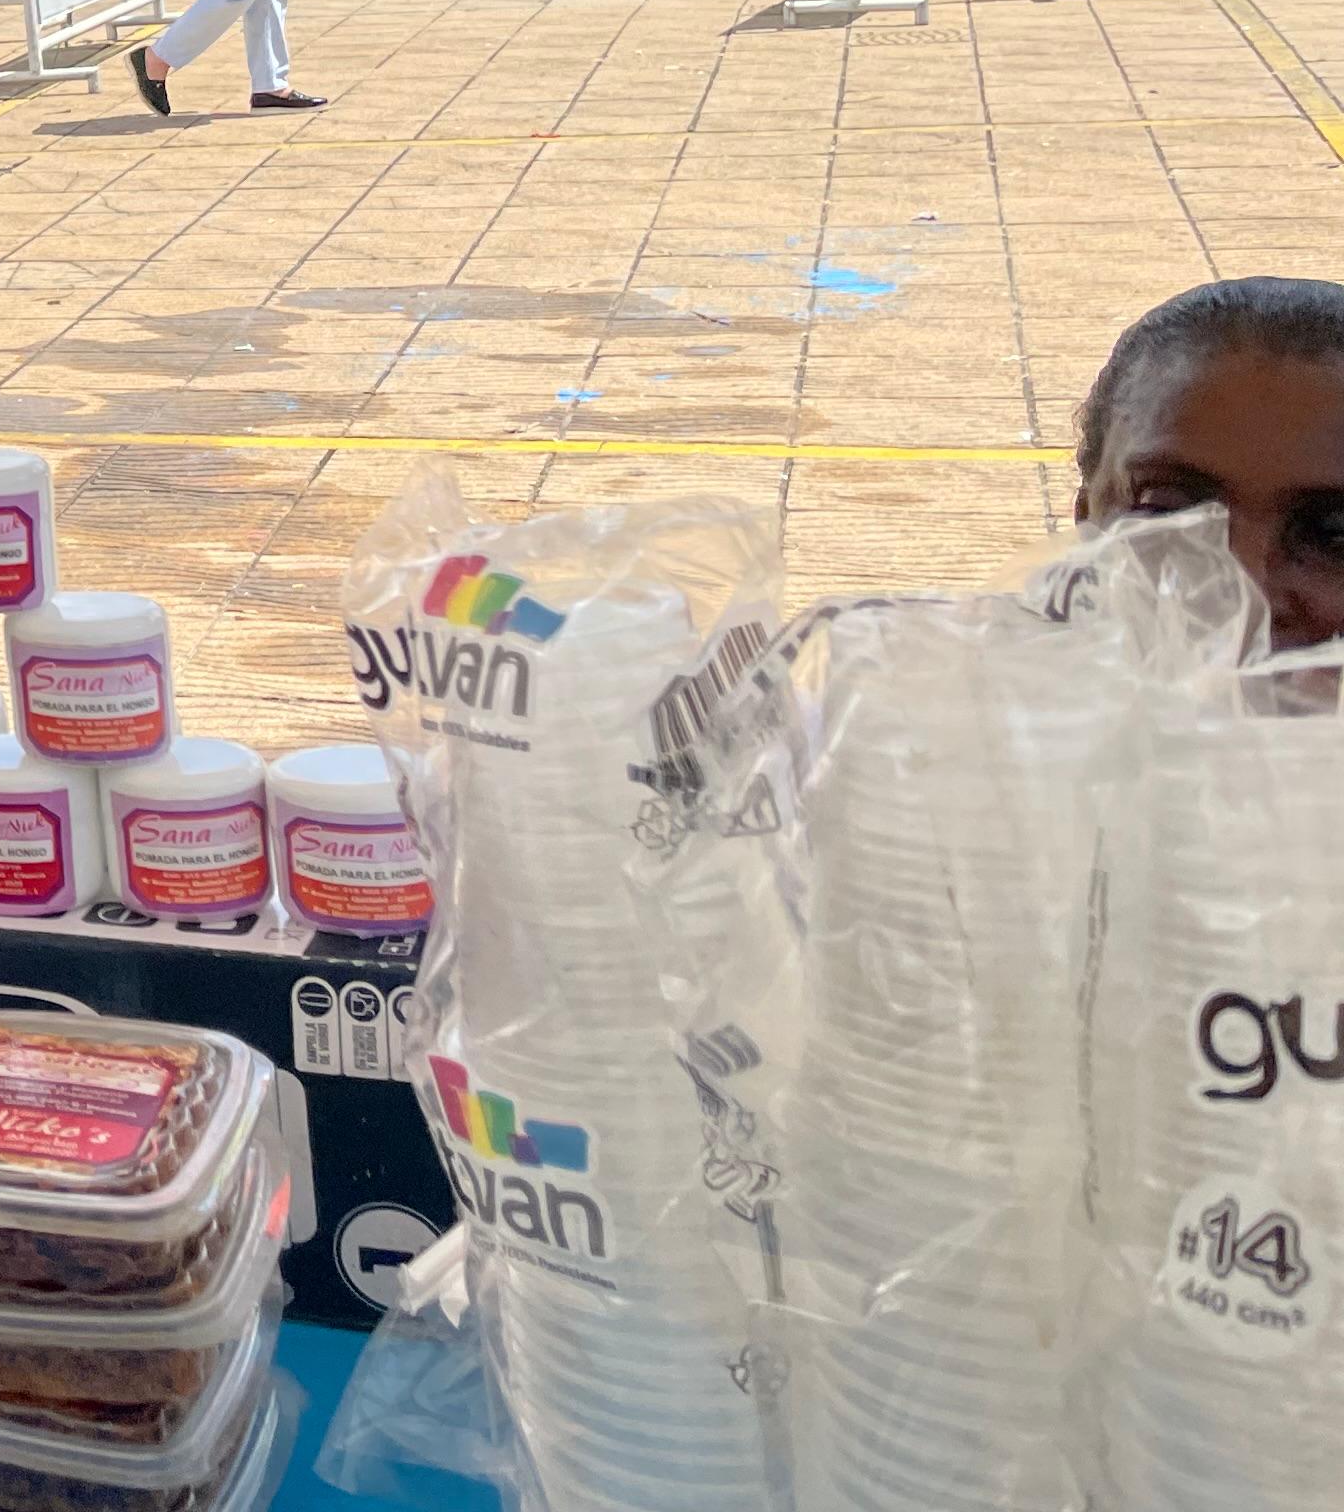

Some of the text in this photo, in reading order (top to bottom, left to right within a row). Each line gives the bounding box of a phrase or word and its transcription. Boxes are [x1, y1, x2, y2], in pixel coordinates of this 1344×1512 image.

[29, 661, 105, 692] Sana
[74, 701, 105, 713] PARA
[106, 702, 121, 713] EL
[133, 814, 211, 844] Sana
[7, 847, 48, 858] HONGO
[294, 824, 374, 860] Sana
[135, 851, 179, 866] POMADA
[181, 854, 211, 866] PARA
[213, 853, 227, 864] EL
[295, 859, 339, 878] POMADA
[340, 869, 373, 881] PARA
[374, 869, 390, 881] EL
